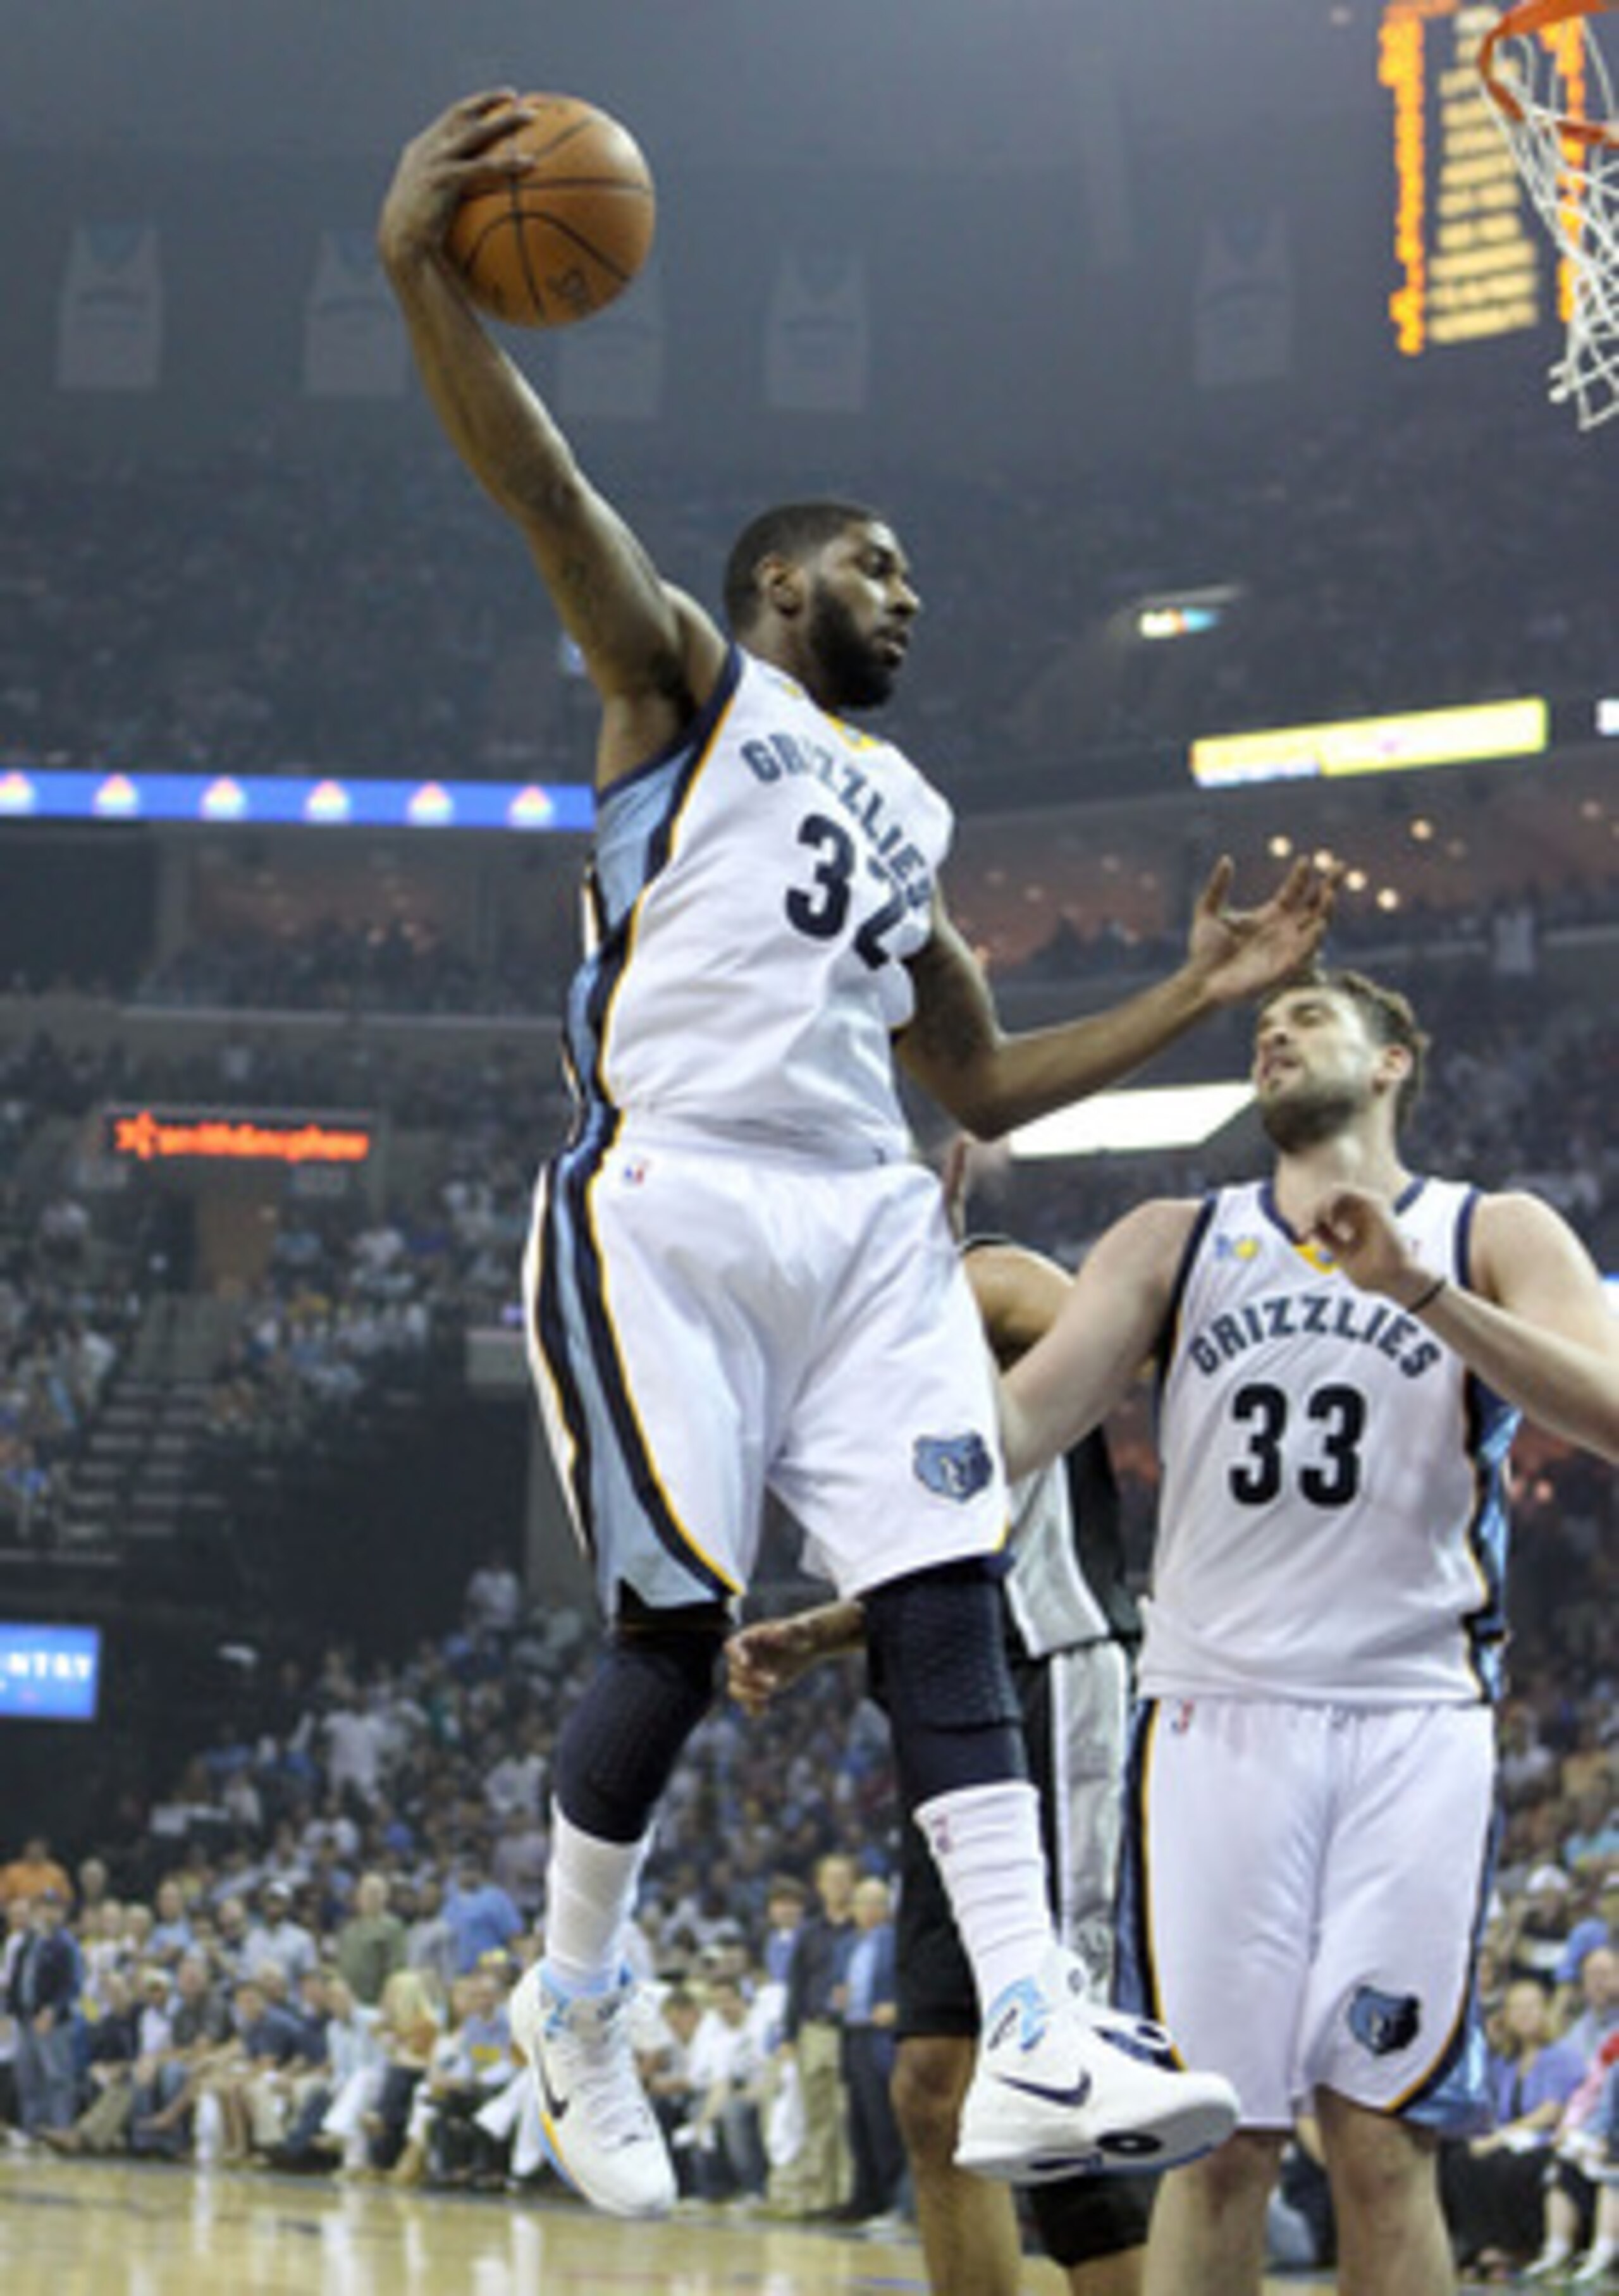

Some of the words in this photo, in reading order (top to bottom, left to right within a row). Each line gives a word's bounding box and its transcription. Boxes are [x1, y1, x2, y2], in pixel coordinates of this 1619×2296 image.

[739, 732, 932, 909] GRZZLIES
[785, 813, 907, 971] 32
[1188, 1295, 1441, 1378] GRIZZLIES
[1229, 1382, 1366, 1507] 33
